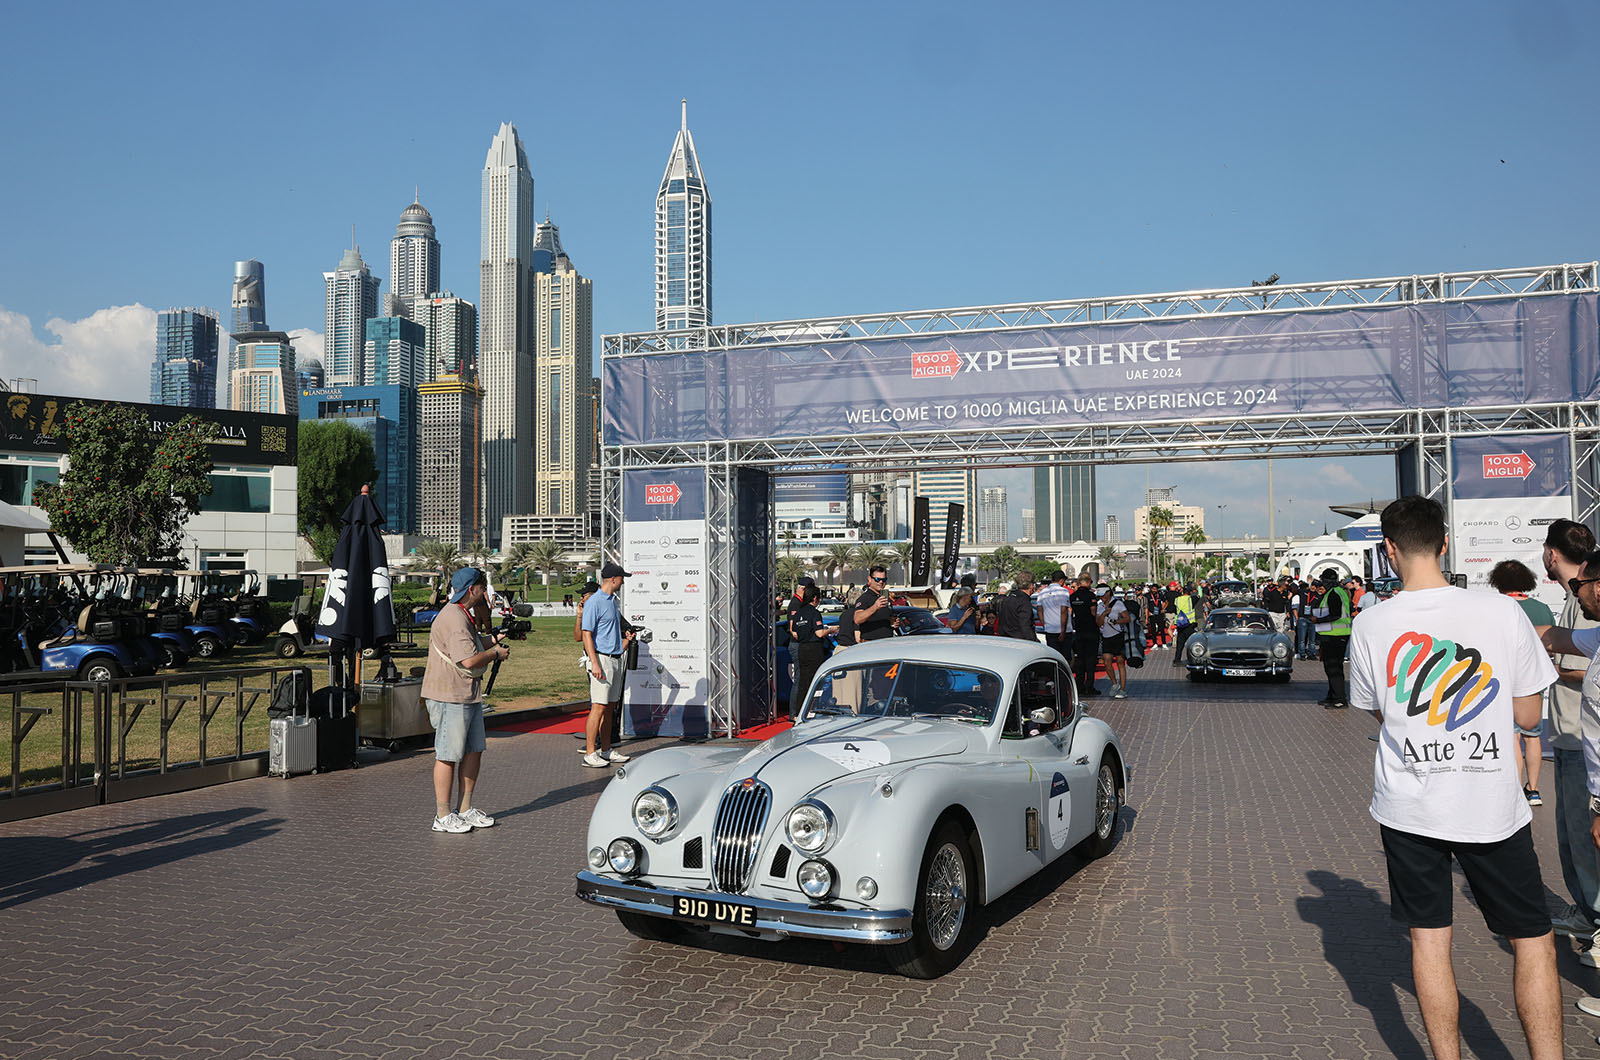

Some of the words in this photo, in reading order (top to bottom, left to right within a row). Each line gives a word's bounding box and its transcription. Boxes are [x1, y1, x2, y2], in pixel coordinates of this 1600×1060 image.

[916, 353, 949, 364] 1000
[963, 340, 1181, 372] XPERIENCE
[914, 365, 952, 376] MIGLIA
[1126, 369, 1149, 380] UAE
[1152, 367, 1182, 379] 2024
[309, 388, 342, 396] LANDMARK
[845, 406, 930, 424] WELCOME
[935, 404, 957, 419] TO
[963, 402, 1002, 418] 1000
[1009, 399, 1068, 416] MIGLIA
[1073, 397, 1108, 413] UAE
[1114, 391, 1227, 411] EXPERIENCE
[1233, 388, 1278, 405] 2024
[1488, 456, 1521, 465] 1000
[1486, 467, 1524, 476] MIGLIA
[649, 486, 673, 494] 1000
[647, 495, 674, 503] MIGLIA
[918, 519, 926, 576] CHOPARD
[885, 663, 899, 680] 4
[843, 742, 860, 753] 4
[1403, 737, 1455, 763] Arte
[1057, 799, 1063, 821] 4
[679, 898, 708, 918] 910
[715, 903, 753, 924] UYE
